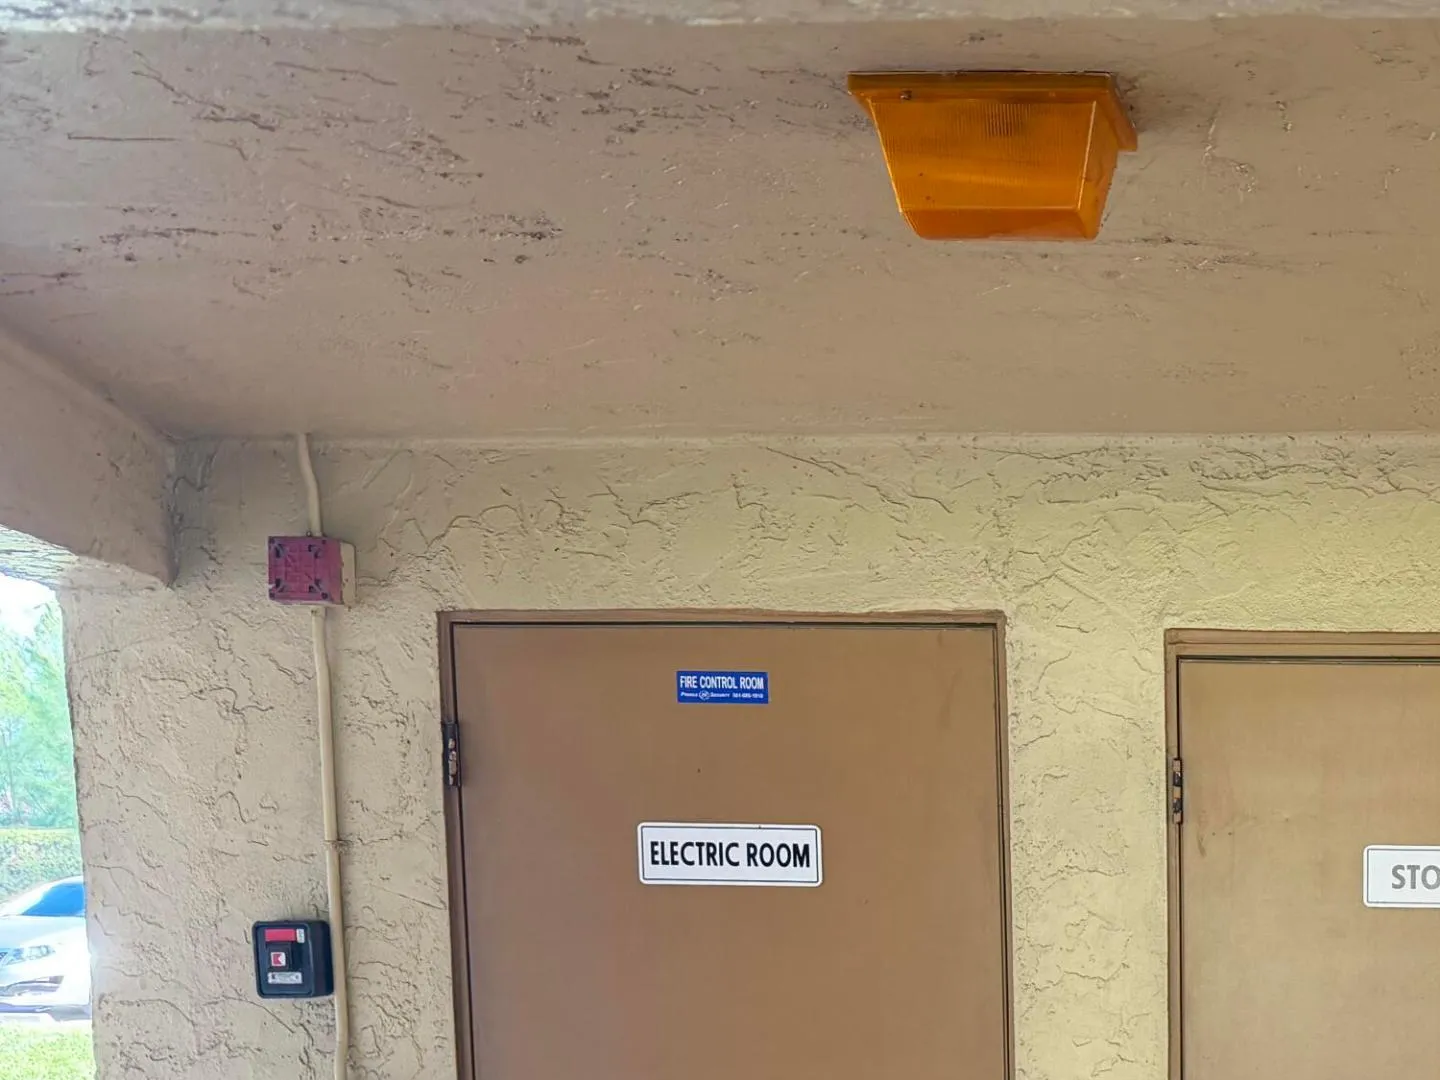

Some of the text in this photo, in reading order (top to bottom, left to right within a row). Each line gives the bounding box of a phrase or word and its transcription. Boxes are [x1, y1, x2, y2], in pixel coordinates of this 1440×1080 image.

[680, 676, 764, 690] FIRE CONTROL ROOM
[650, 841, 810, 868] ELECTRIC ROOM
